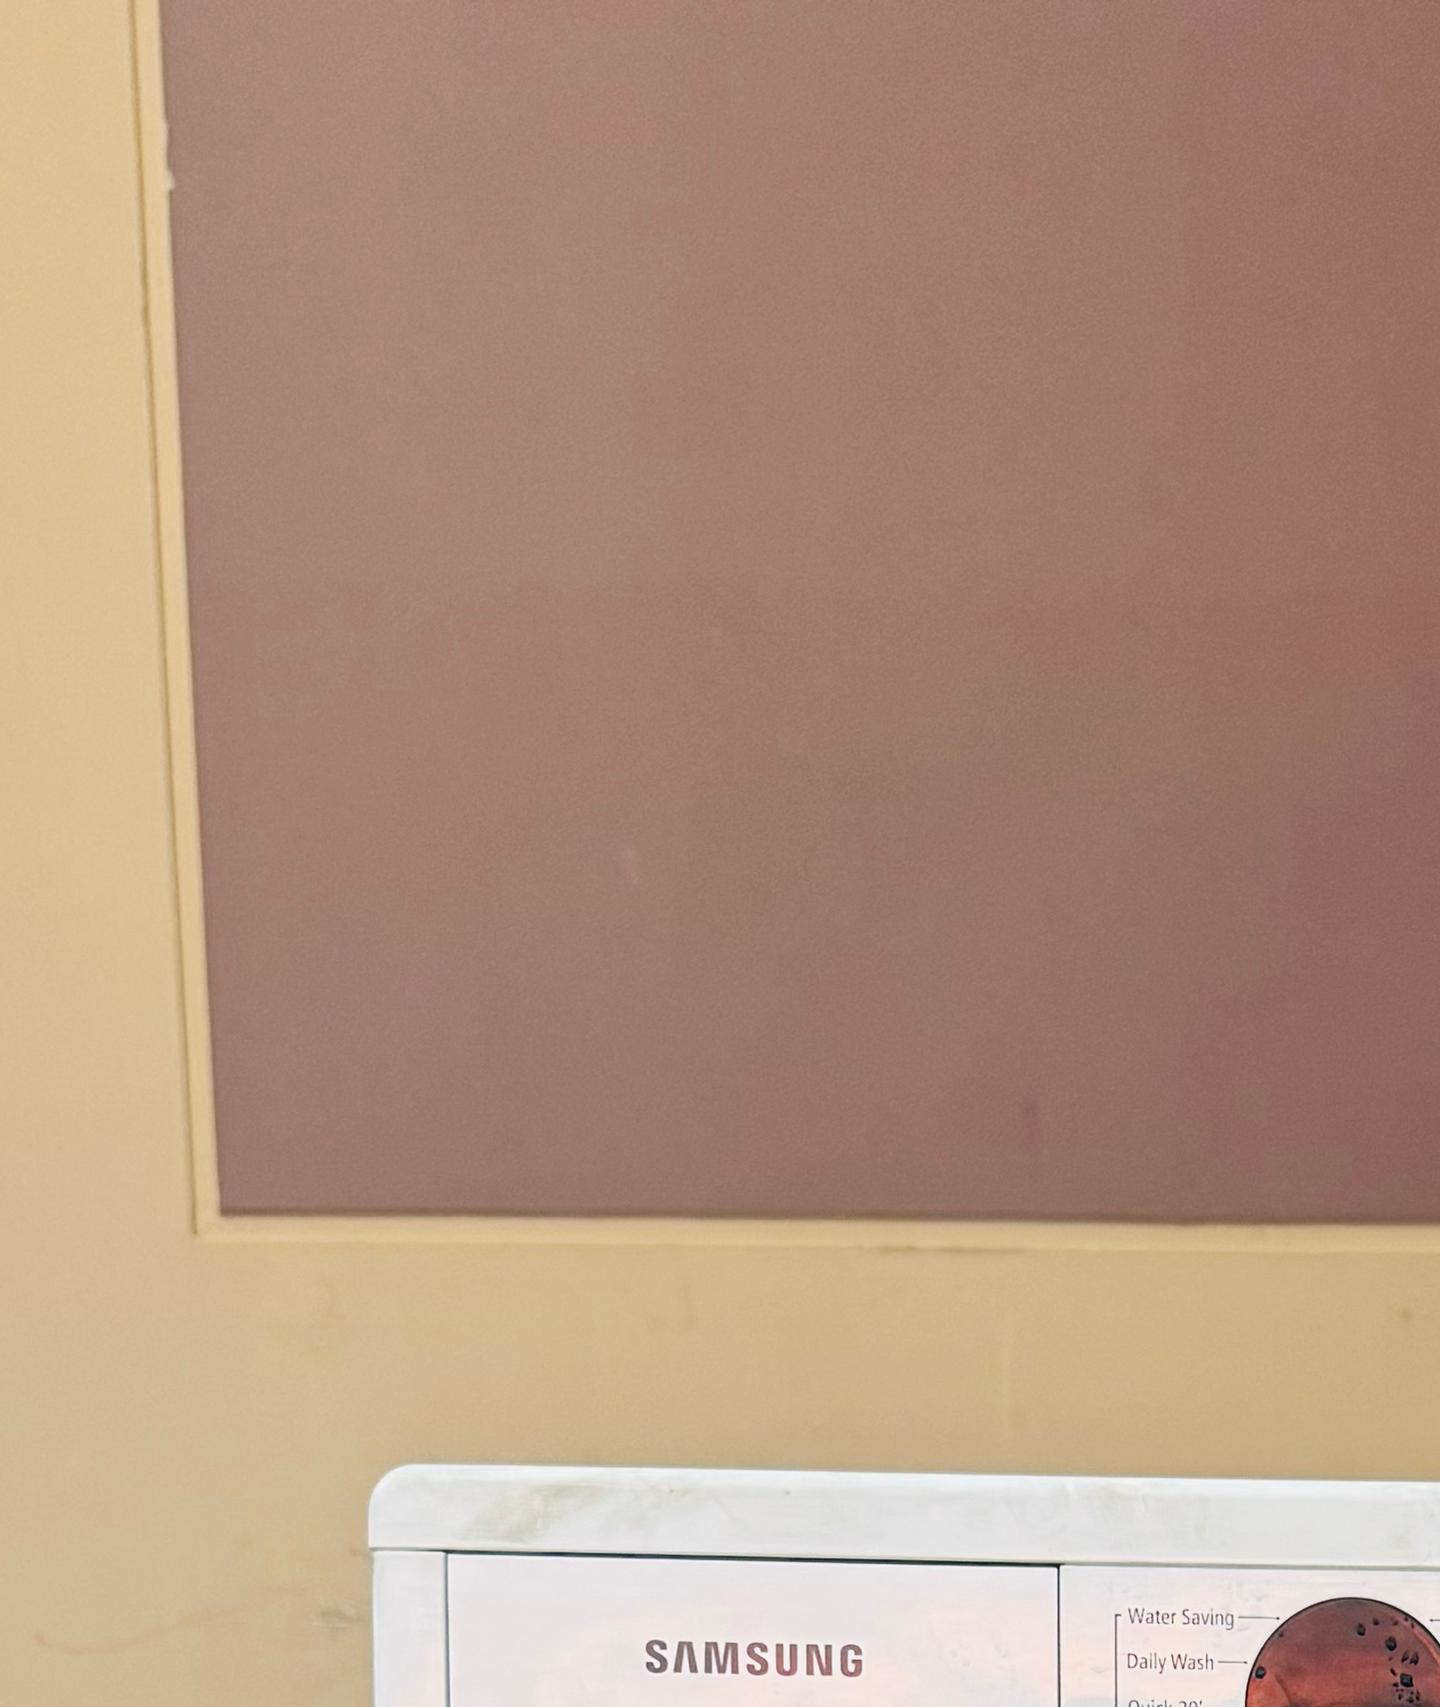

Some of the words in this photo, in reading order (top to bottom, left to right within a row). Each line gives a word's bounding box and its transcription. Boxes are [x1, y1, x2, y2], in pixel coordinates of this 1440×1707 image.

[1127, 1609, 1178, 1627] Water
[1181, 1609, 1235, 1629] Saving
[645, 1639, 863, 1677] SAMSUNG
[1126, 1654, 1167, 1673] Daily
[1171, 1654, 1215, 1671] Wash
